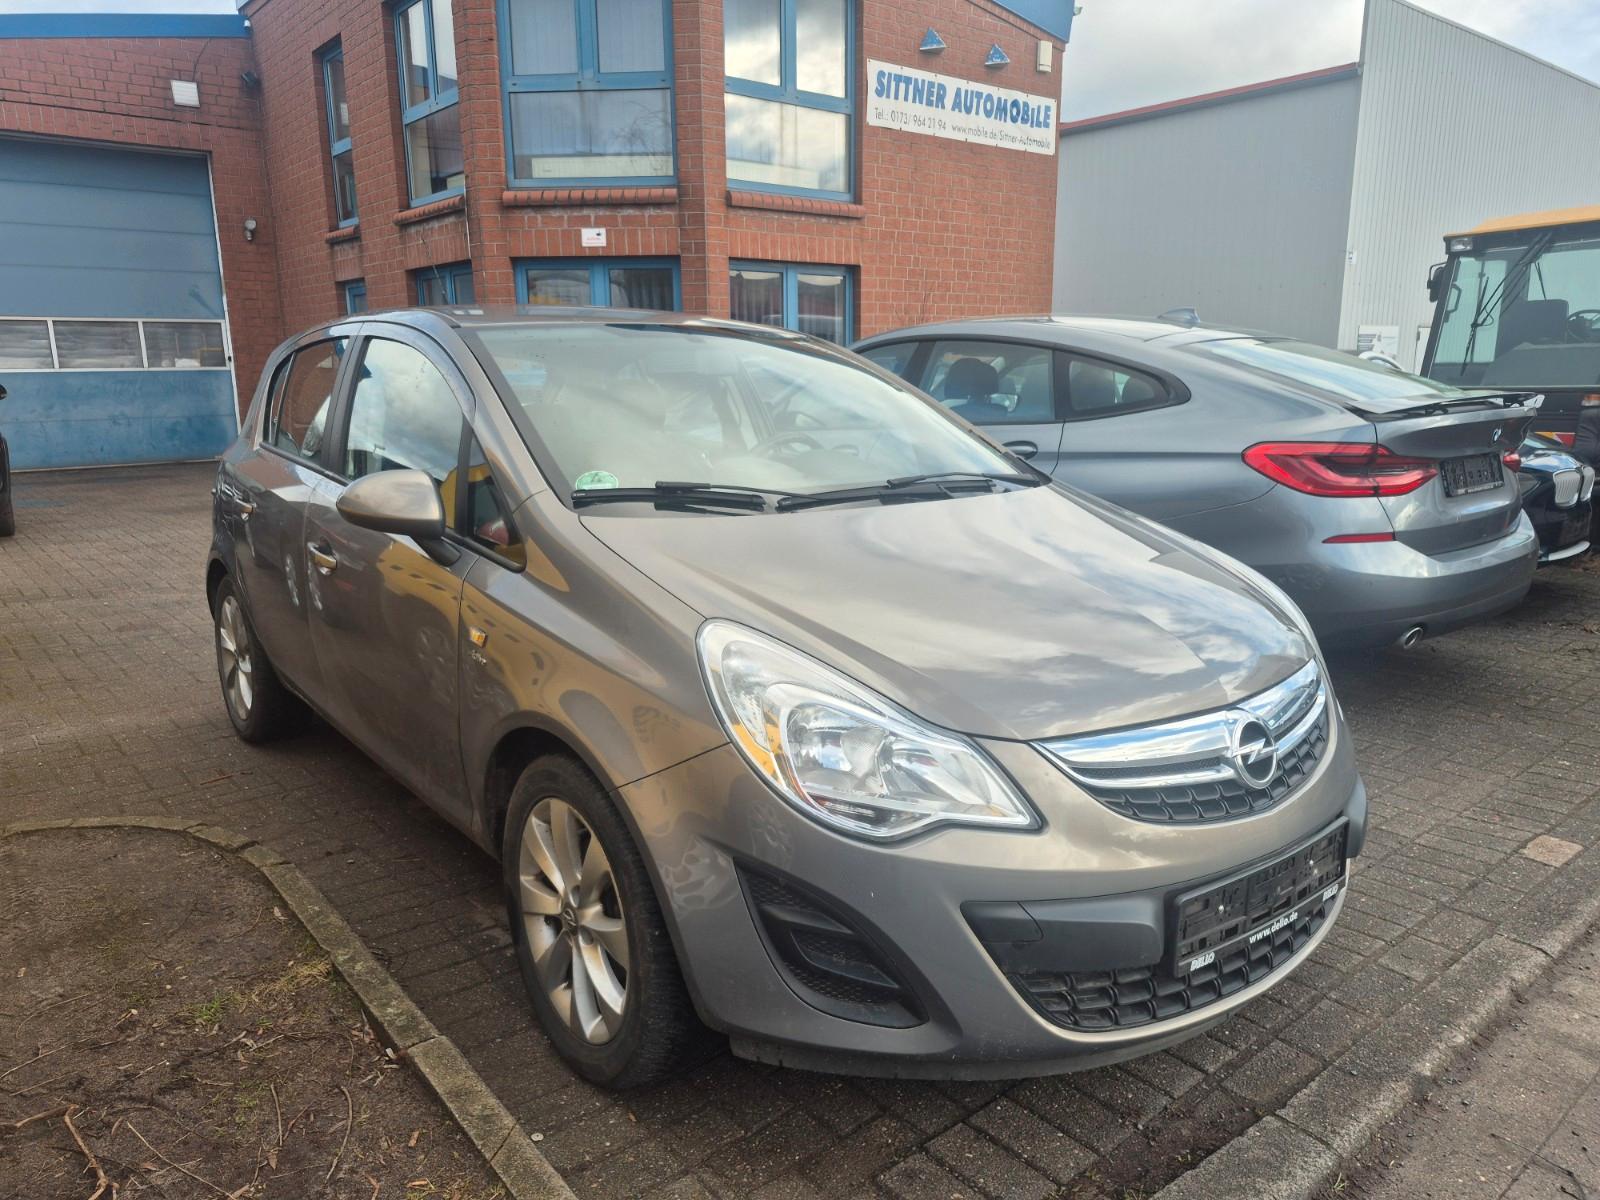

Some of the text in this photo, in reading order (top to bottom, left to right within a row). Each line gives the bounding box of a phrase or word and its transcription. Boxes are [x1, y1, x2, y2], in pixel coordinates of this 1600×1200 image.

[874, 69, 1051, 129] SITTNER AUTOMOBILE
[912, 113, 926, 127] 964
[927, 116, 936, 129] 21
[1249, 911, 1299, 944] www.dello.de
